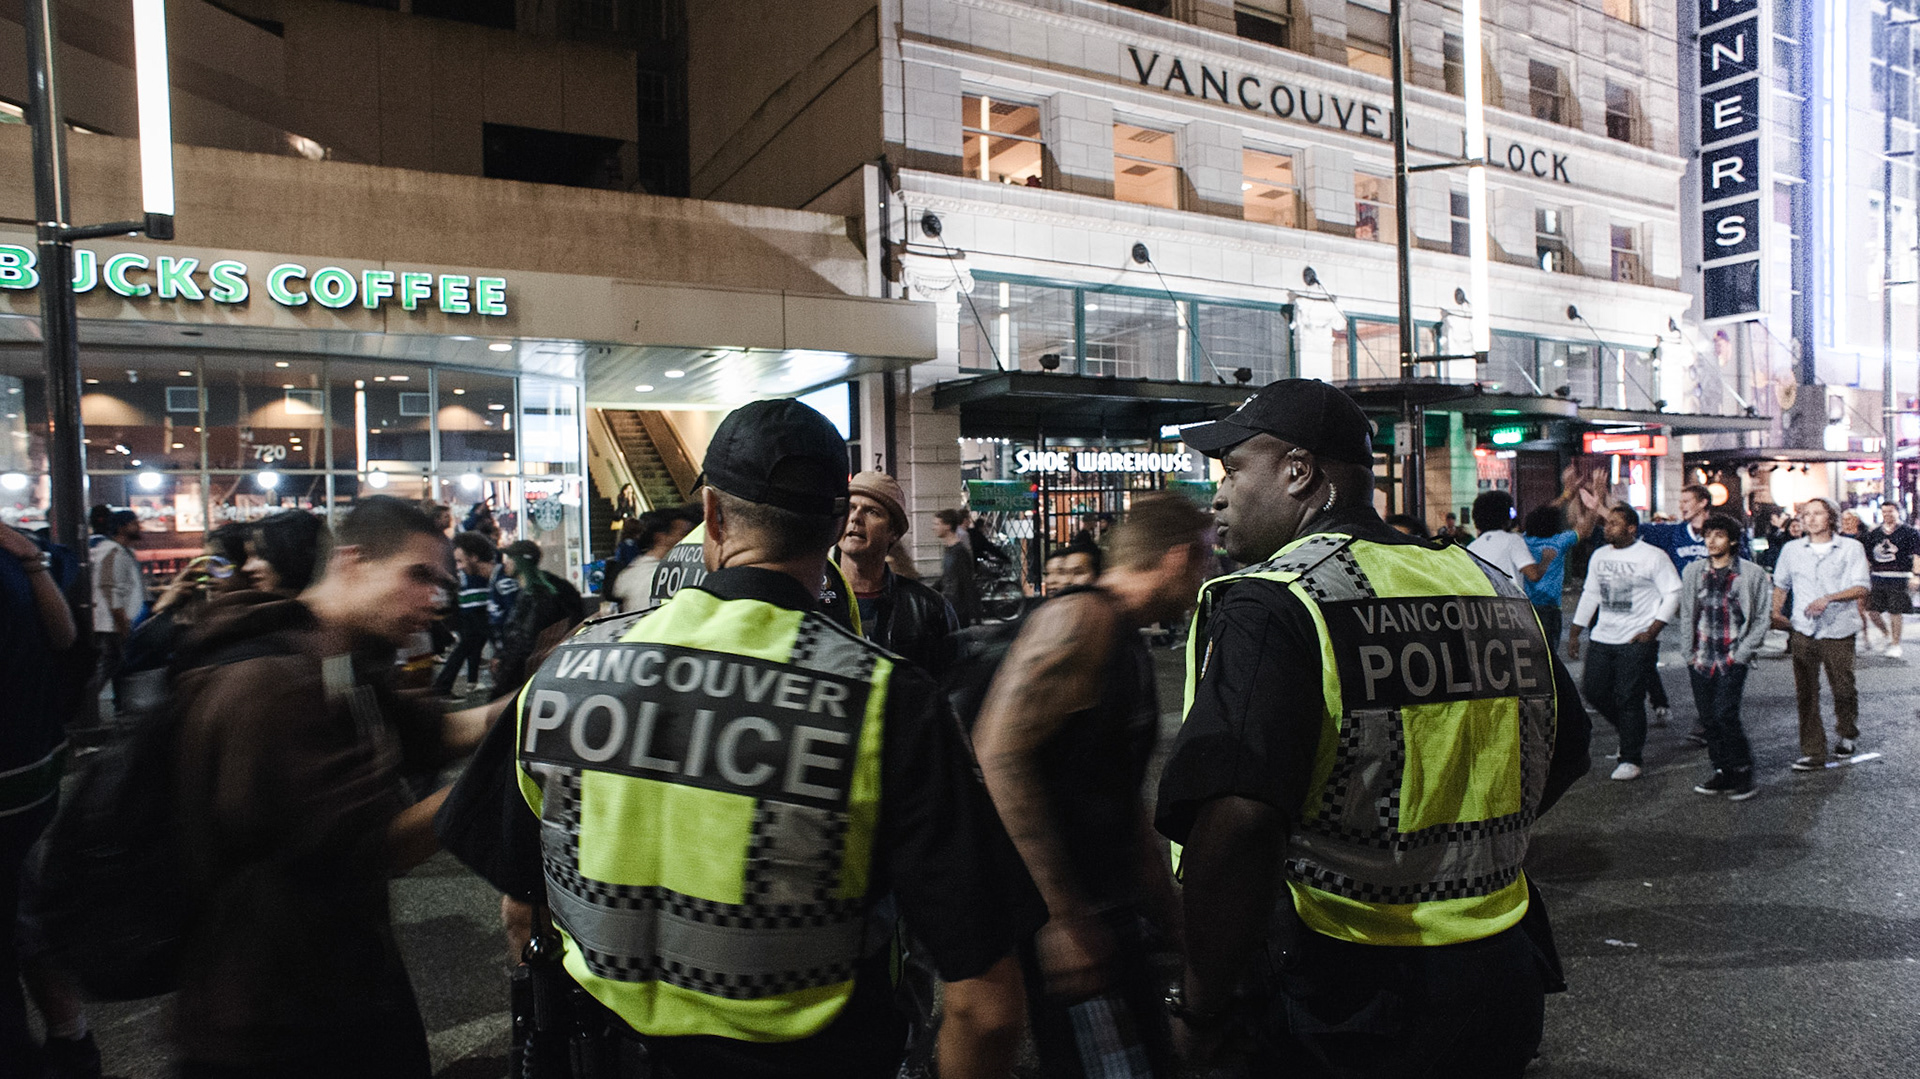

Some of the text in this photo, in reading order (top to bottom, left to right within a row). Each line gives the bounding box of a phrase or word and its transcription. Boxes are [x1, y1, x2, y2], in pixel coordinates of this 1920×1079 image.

[1710, 0, 1747, 246] NERS
[1462, 130, 1571, 183] LOCK
[266, 262, 508, 316] COFFEE
[252, 444, 287, 461] 720
[1015, 449, 1192, 474] SHOE WAREHOUSE
[1352, 601, 1525, 635] VANCOUVER
[554, 648, 850, 718] VANCOUVER
[1358, 638, 1538, 701] POLICE
[523, 688, 852, 800] POLICE
